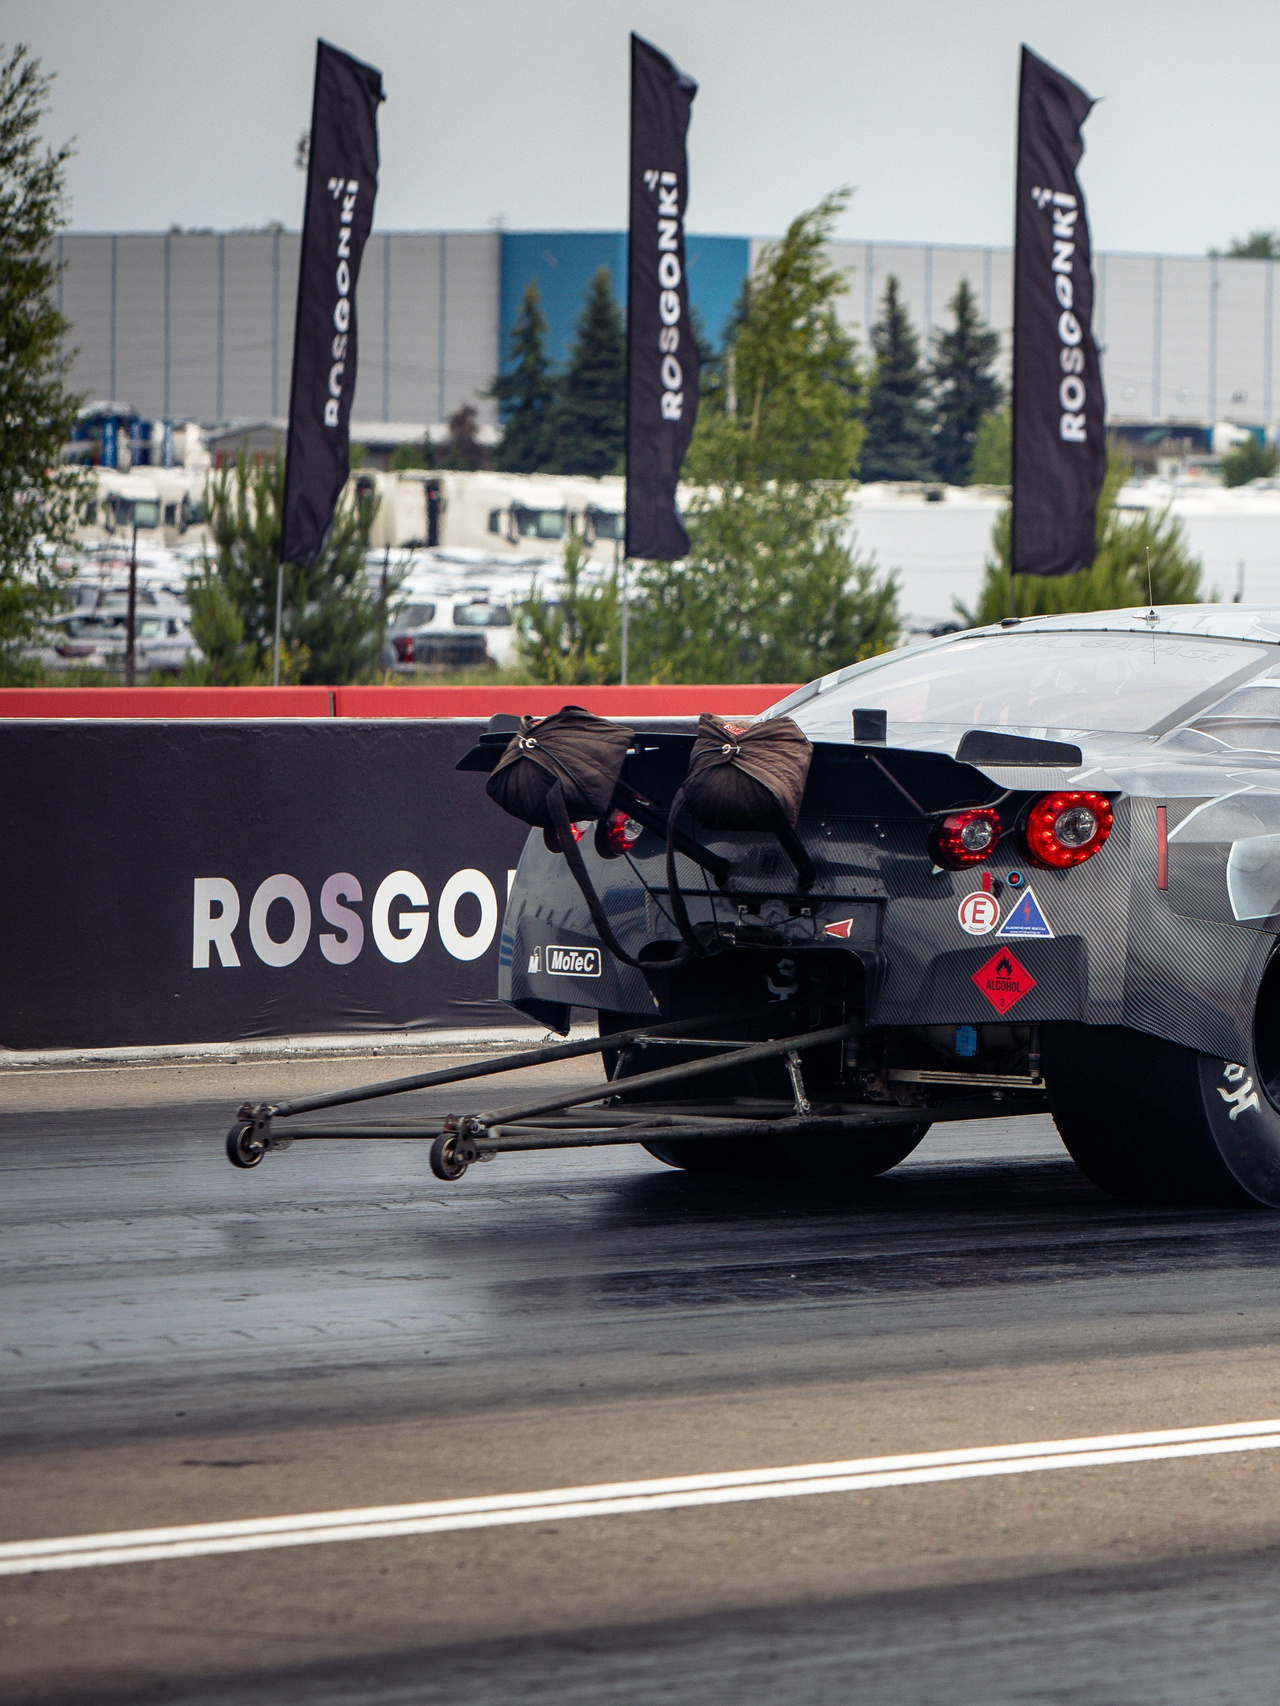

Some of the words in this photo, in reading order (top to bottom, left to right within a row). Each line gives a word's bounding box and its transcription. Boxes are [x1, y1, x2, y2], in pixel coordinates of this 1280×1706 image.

[324, 179, 359, 427] ROSGONKI
[658, 171, 684, 421] ROSGONKI
[1052, 191, 1087, 443] ROSGONKI
[193, 868, 518, 968] ROSGO
[551, 950, 596, 972] MoTeC
[972, 901, 987, 924] E
[986, 980, 1021, 992] ALCOHOL
